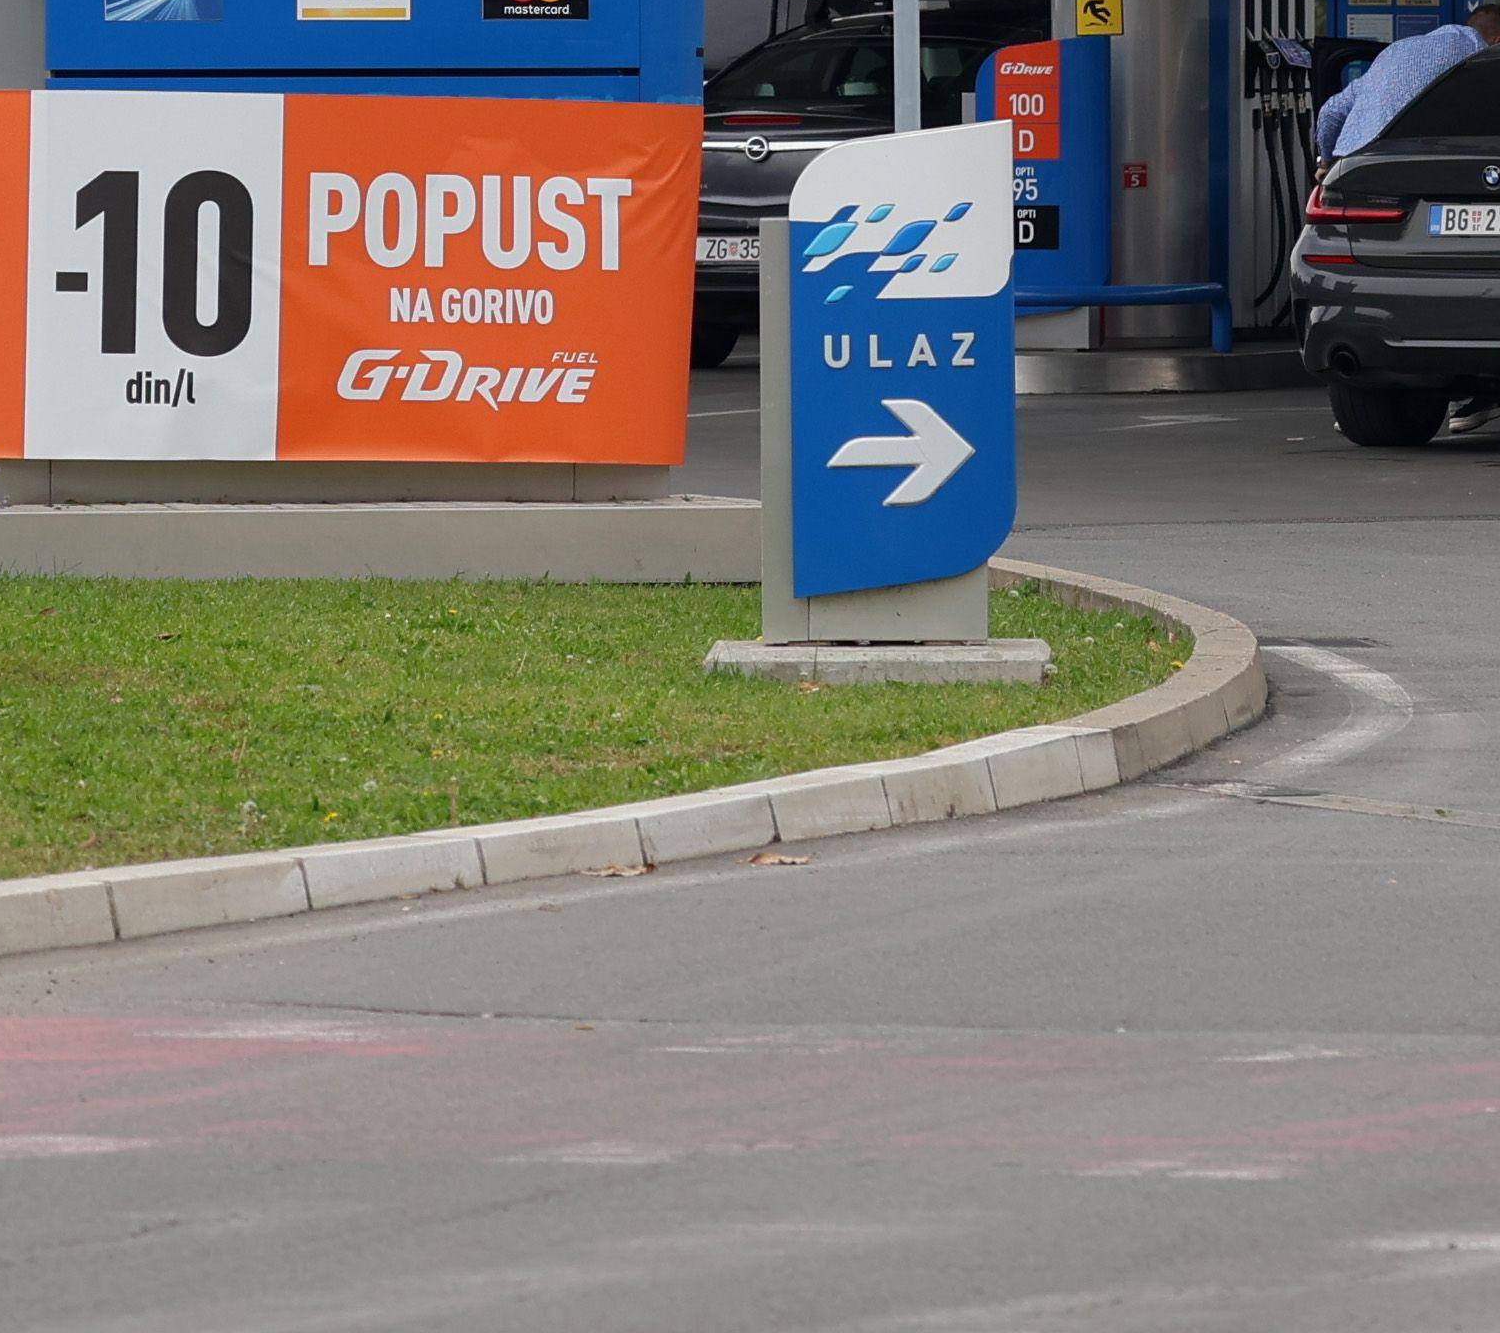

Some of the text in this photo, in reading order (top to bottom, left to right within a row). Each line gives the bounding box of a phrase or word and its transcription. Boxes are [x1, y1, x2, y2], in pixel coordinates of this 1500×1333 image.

[504, 4, 570, 15] mastercard
[1009, 94, 1044, 116] 100
[1018, 130, 1034, 152] D
[1015, 167, 1034, 176] OPTI
[1131, 174, 1140, 187] 5
[1013, 179, 1038, 201] 95
[308, 171, 631, 272] POPUST
[1017, 209, 1036, 218] OPTI
[1445, 208, 1469, 231] BG
[1018, 221, 1034, 244] D
[706, 239, 728, 259] ZG
[54, 169, 253, 357] -10
[389, 287, 553, 326] NA GORIVO
[551, 351, 598, 365] FUEL
[823, 332, 975, 369] ULAZ
[125, 369, 197, 406] din/l
